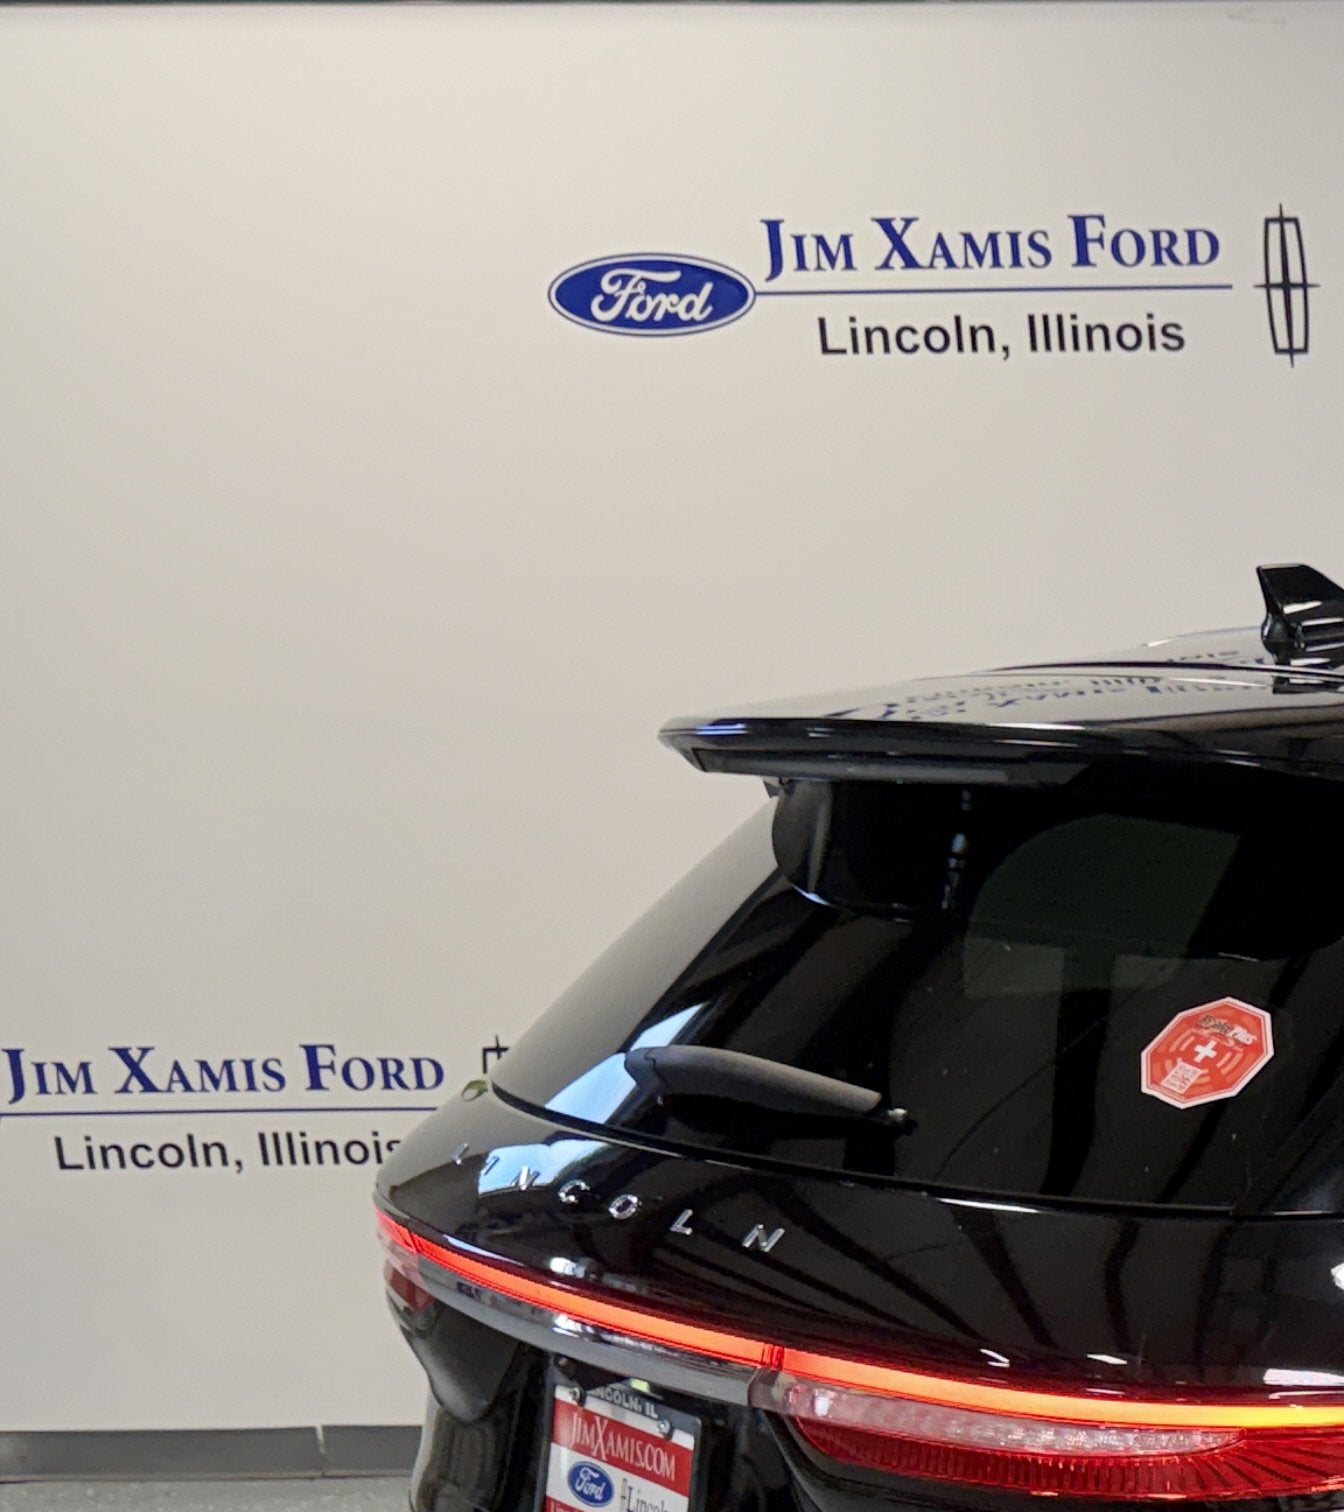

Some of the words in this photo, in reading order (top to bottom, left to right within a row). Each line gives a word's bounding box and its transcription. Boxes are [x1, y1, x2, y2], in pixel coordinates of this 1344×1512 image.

[759, 217, 855, 282] JIM
[870, 216, 1053, 270] XAMIS
[1066, 213, 1220, 268] FORD
[590, 267, 714, 323] Ford
[817, 314, 1011, 362] Lincoln,
[1027, 312, 1186, 353] Illinois
[0, 1047, 98, 1106] JIM
[107, 1046, 287, 1095] XAMIS
[298, 1043, 445, 1092] FORD
[53, 1132, 244, 1174] Lincoln,
[574, 1466, 606, 1501] Ford
